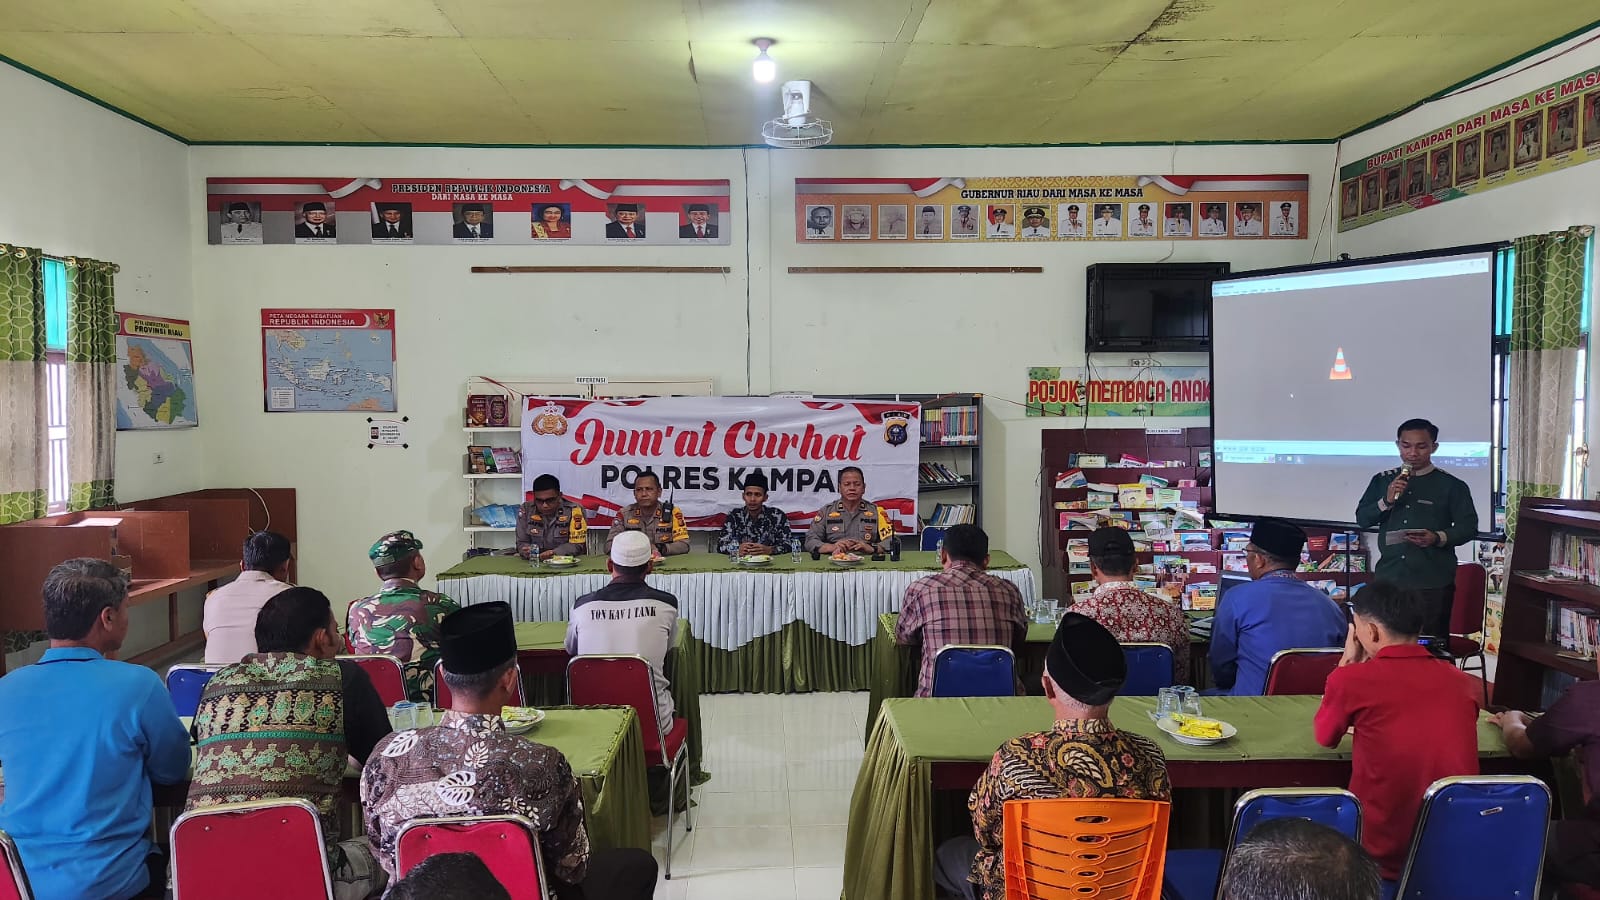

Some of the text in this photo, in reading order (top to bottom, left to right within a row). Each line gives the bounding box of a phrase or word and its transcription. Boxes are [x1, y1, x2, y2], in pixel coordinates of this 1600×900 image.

[1367, 147, 1402, 170] BUPATI
[1406, 128, 1453, 154] KAMPAR
[1456, 114, 1486, 135] DARI
[1490, 98, 1530, 122] MASA
[1535, 88, 1556, 106] KE
[392, 184, 551, 193] PRESIDEN REPUBLIK INDONESIA
[960, 188, 1143, 199] GUBERNUR RIAU DARI MASA KE MASA
[134, 325, 183, 337] PROVINSI RIAU
[1028, 380, 1080, 403] POJOK
[1085, 380, 1166, 403] MEMBACA
[570, 418, 866, 466] Jum'at Curhat
[601, 464, 720, 491] PORES
[591, 609, 607, 620] YON
[609, 608, 626, 620] KAV
